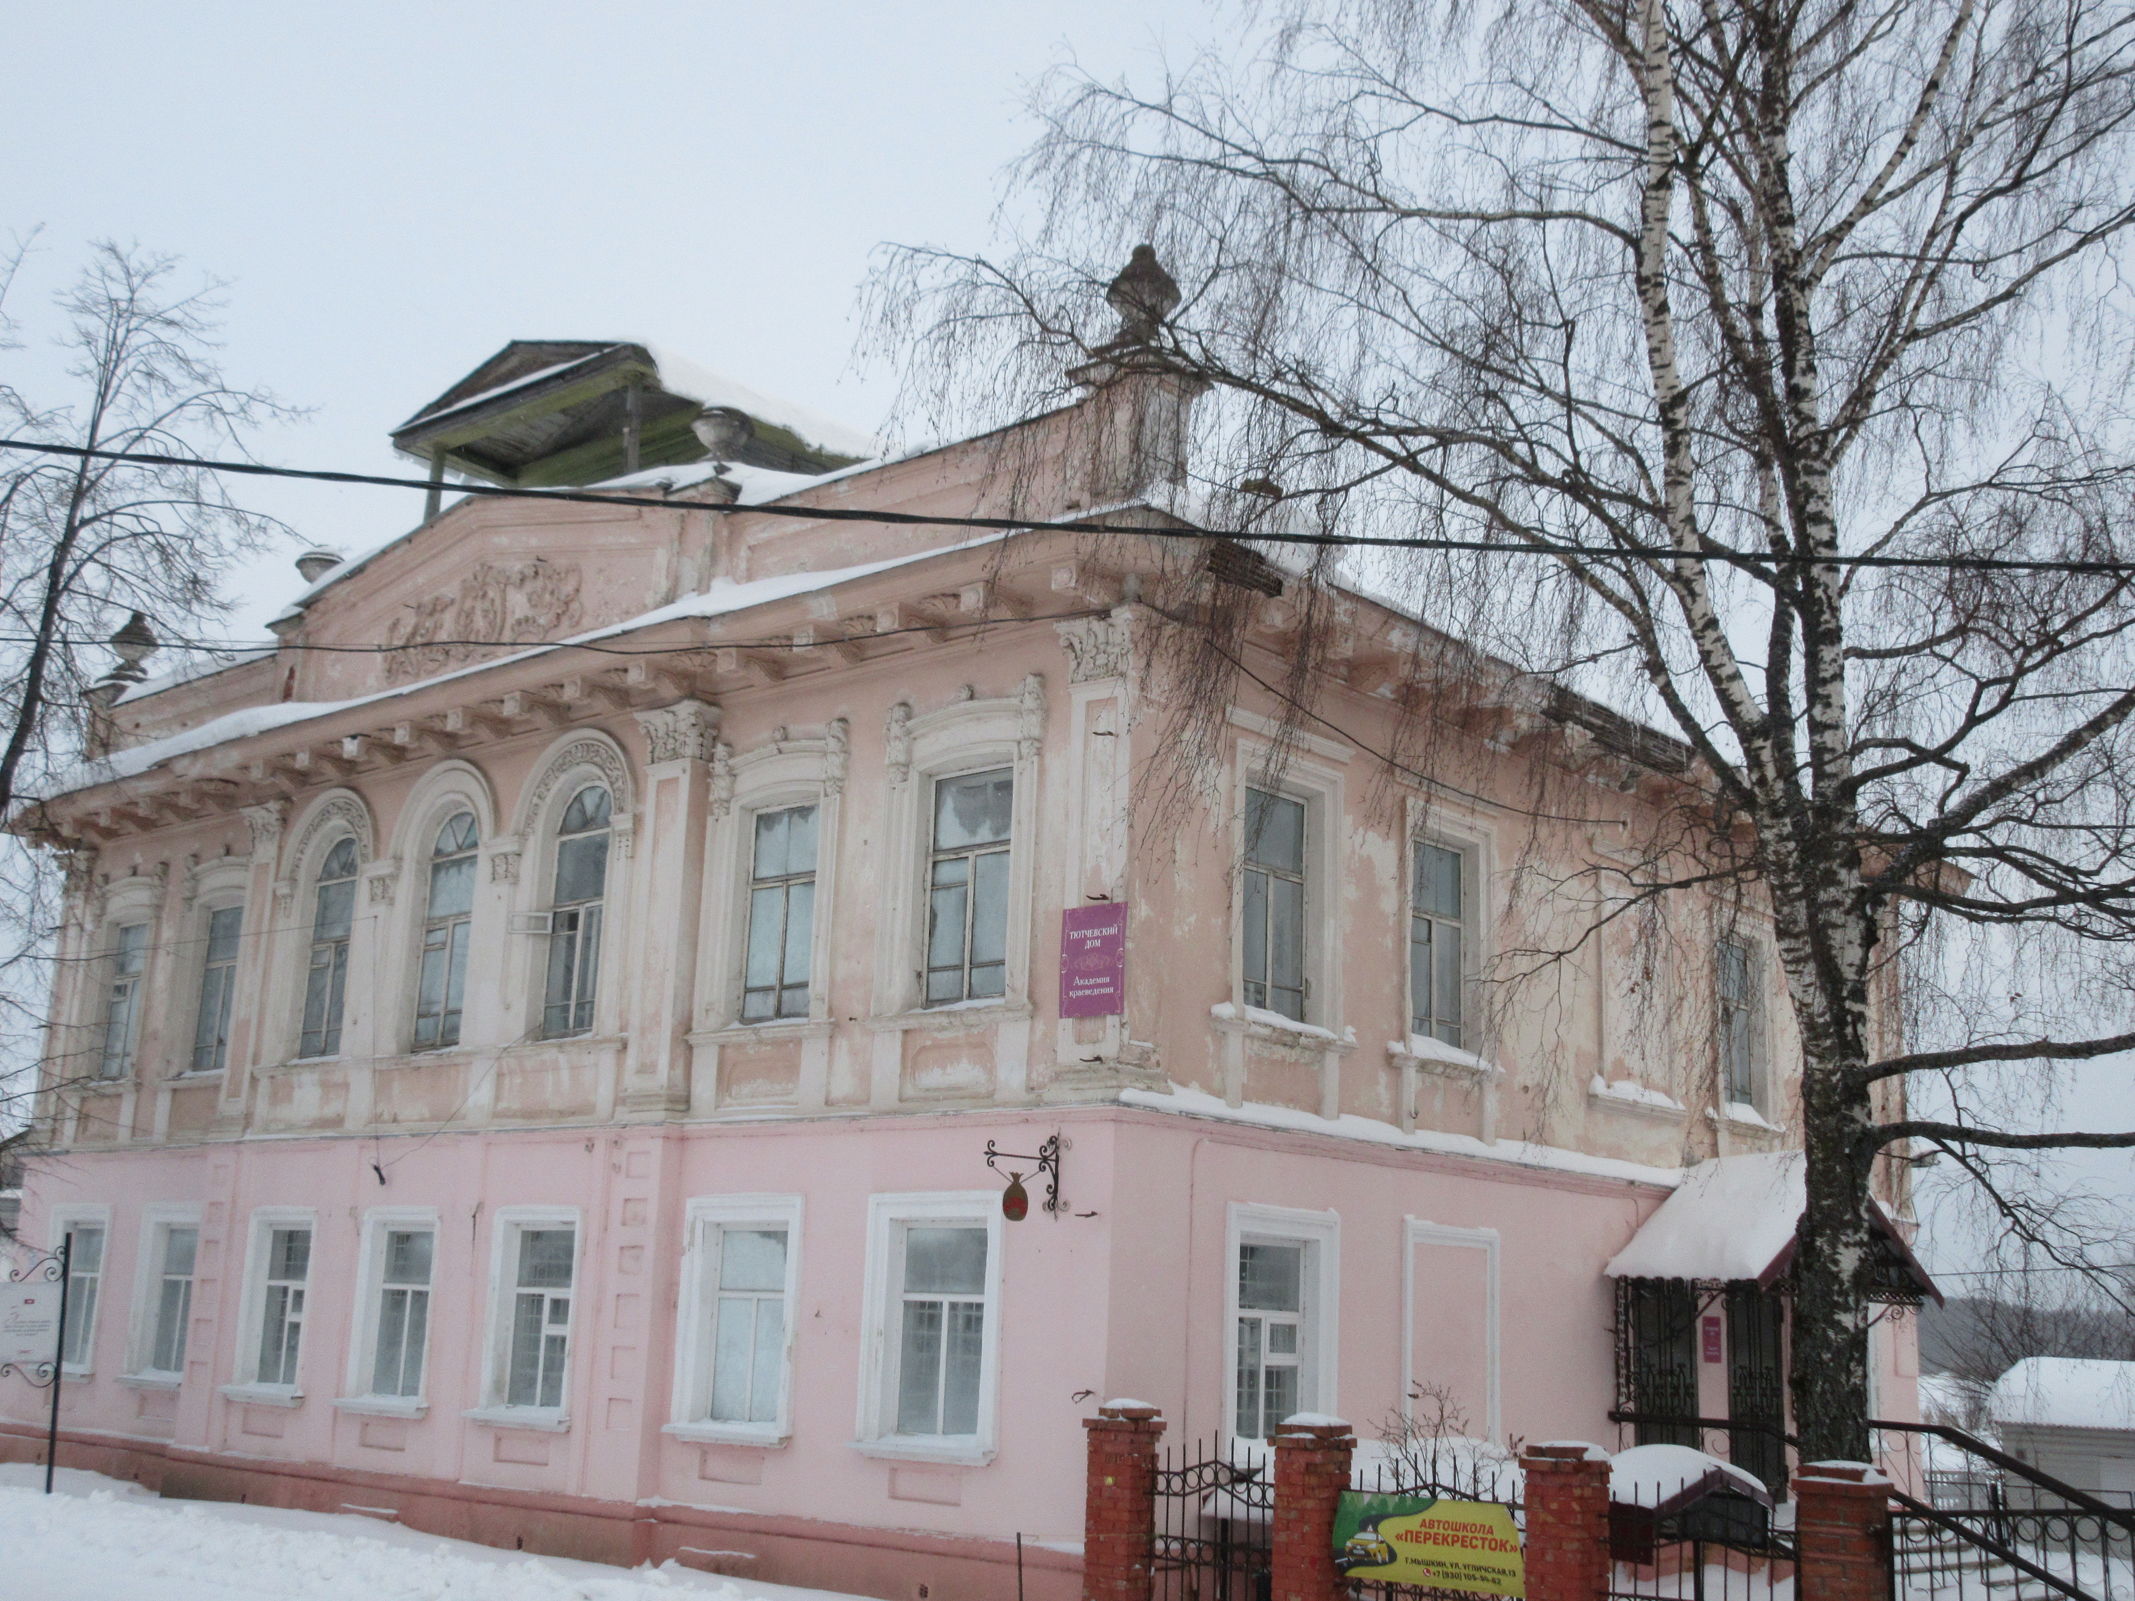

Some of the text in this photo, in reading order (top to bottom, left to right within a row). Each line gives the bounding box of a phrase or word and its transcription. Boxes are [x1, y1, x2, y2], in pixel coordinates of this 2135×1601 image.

[1069, 923, 1118, 940] ТЮТЧЕВСКИЙ
[1085, 939, 1101, 950] ДОМ
[1073, 976, 1110, 986] Академия
[1069, 986, 1114, 999] краеведения
[1419, 1518, 1495, 1536] АВТОШКОЛА
[1395, 1529, 1518, 1553] «ПЕРЕКРЕСТОК»
